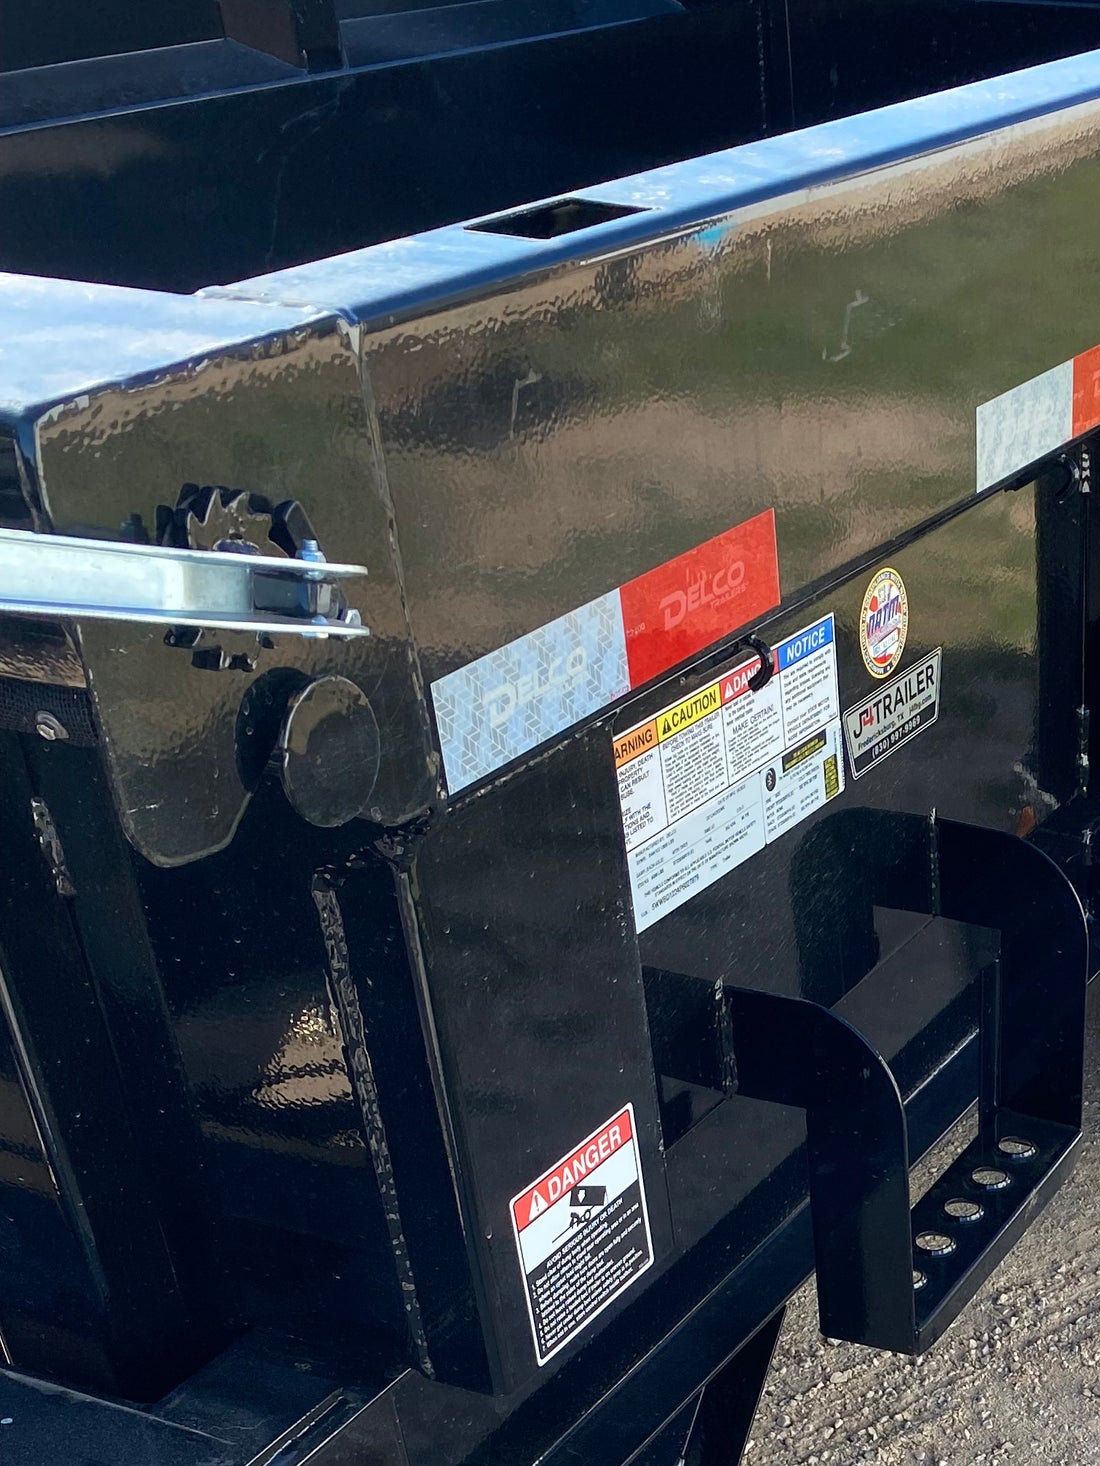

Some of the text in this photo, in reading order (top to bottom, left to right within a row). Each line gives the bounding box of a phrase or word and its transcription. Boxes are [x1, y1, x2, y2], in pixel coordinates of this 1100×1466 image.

[659, 560, 744, 632] DELCO
[786, 626, 825, 663] NOTICE
[671, 689, 717, 728] CAUTION
[897, 711, 904, 722] TX
[615, 728, 652, 761] ARNING
[548, 1125, 622, 1202] DANGER
